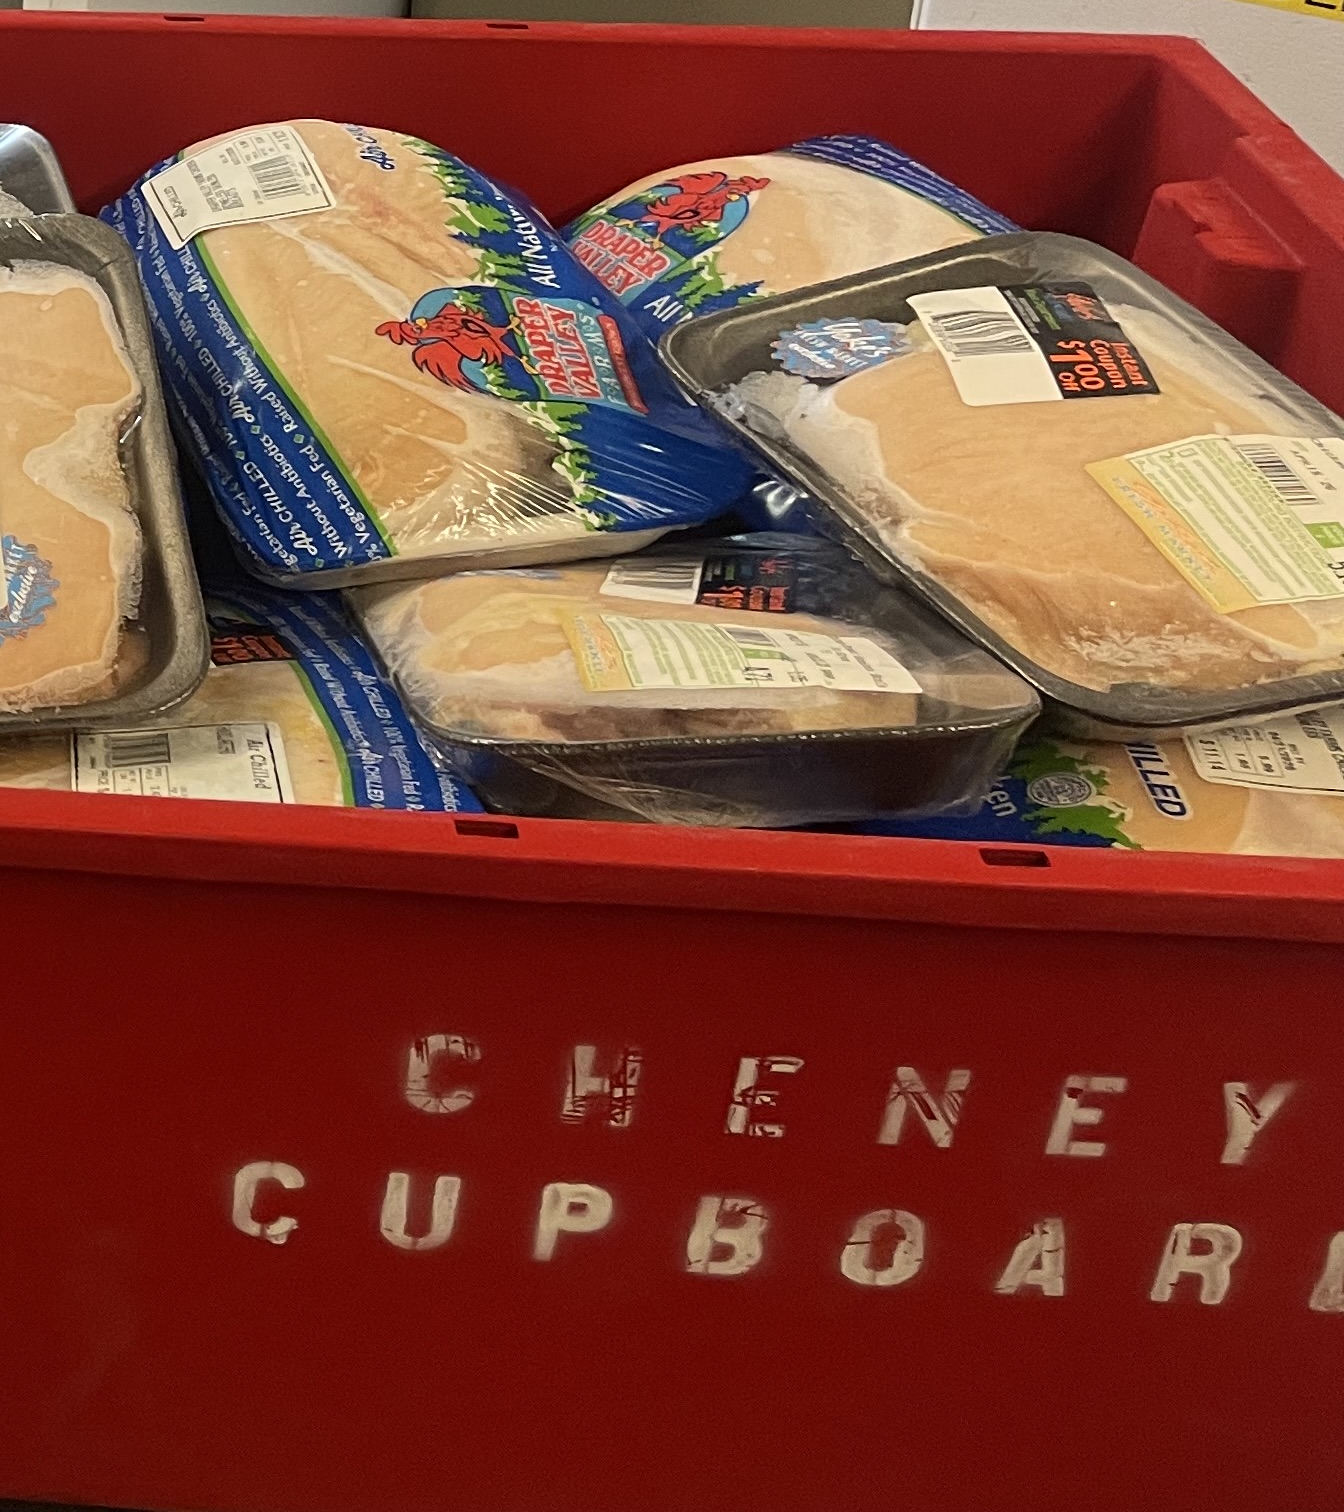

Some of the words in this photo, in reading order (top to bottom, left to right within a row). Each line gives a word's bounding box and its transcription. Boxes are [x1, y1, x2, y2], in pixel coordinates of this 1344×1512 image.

[570, 240, 644, 297] VALLEY
[579, 219, 672, 281] DRAPER
[530, 263, 562, 289] All
[643, 294, 685, 322] All
[197, 347, 236, 398] CHILLED
[231, 347, 269, 395] Without
[513, 297, 569, 398] DRAPER
[542, 302, 603, 400] VALLEY
[1089, 337, 1128, 389] Coupon
[1111, 341, 1148, 387] Instant
[1056, 371, 1081, 394] Off
[261, 390, 299, 434] Raised
[260, 433, 311, 498] Antibiotics
[299, 443, 325, 474] Fed
[242, 460, 294, 523] CHILLED
[320, 470, 371, 545] Vegetarian
[289, 521, 319, 556] Air
[305, 502, 348, 559] Without
[8, 565, 39, 624] exclusive
[362, 685, 392, 720] CHILLED
[246, 738, 265, 753] Air
[248, 754, 273, 791] Chilled
[363, 765, 385, 802] CHILLED
[1125, 742, 1190, 819] ILLED
[404, 1032, 1296, 1167] CHENEY
